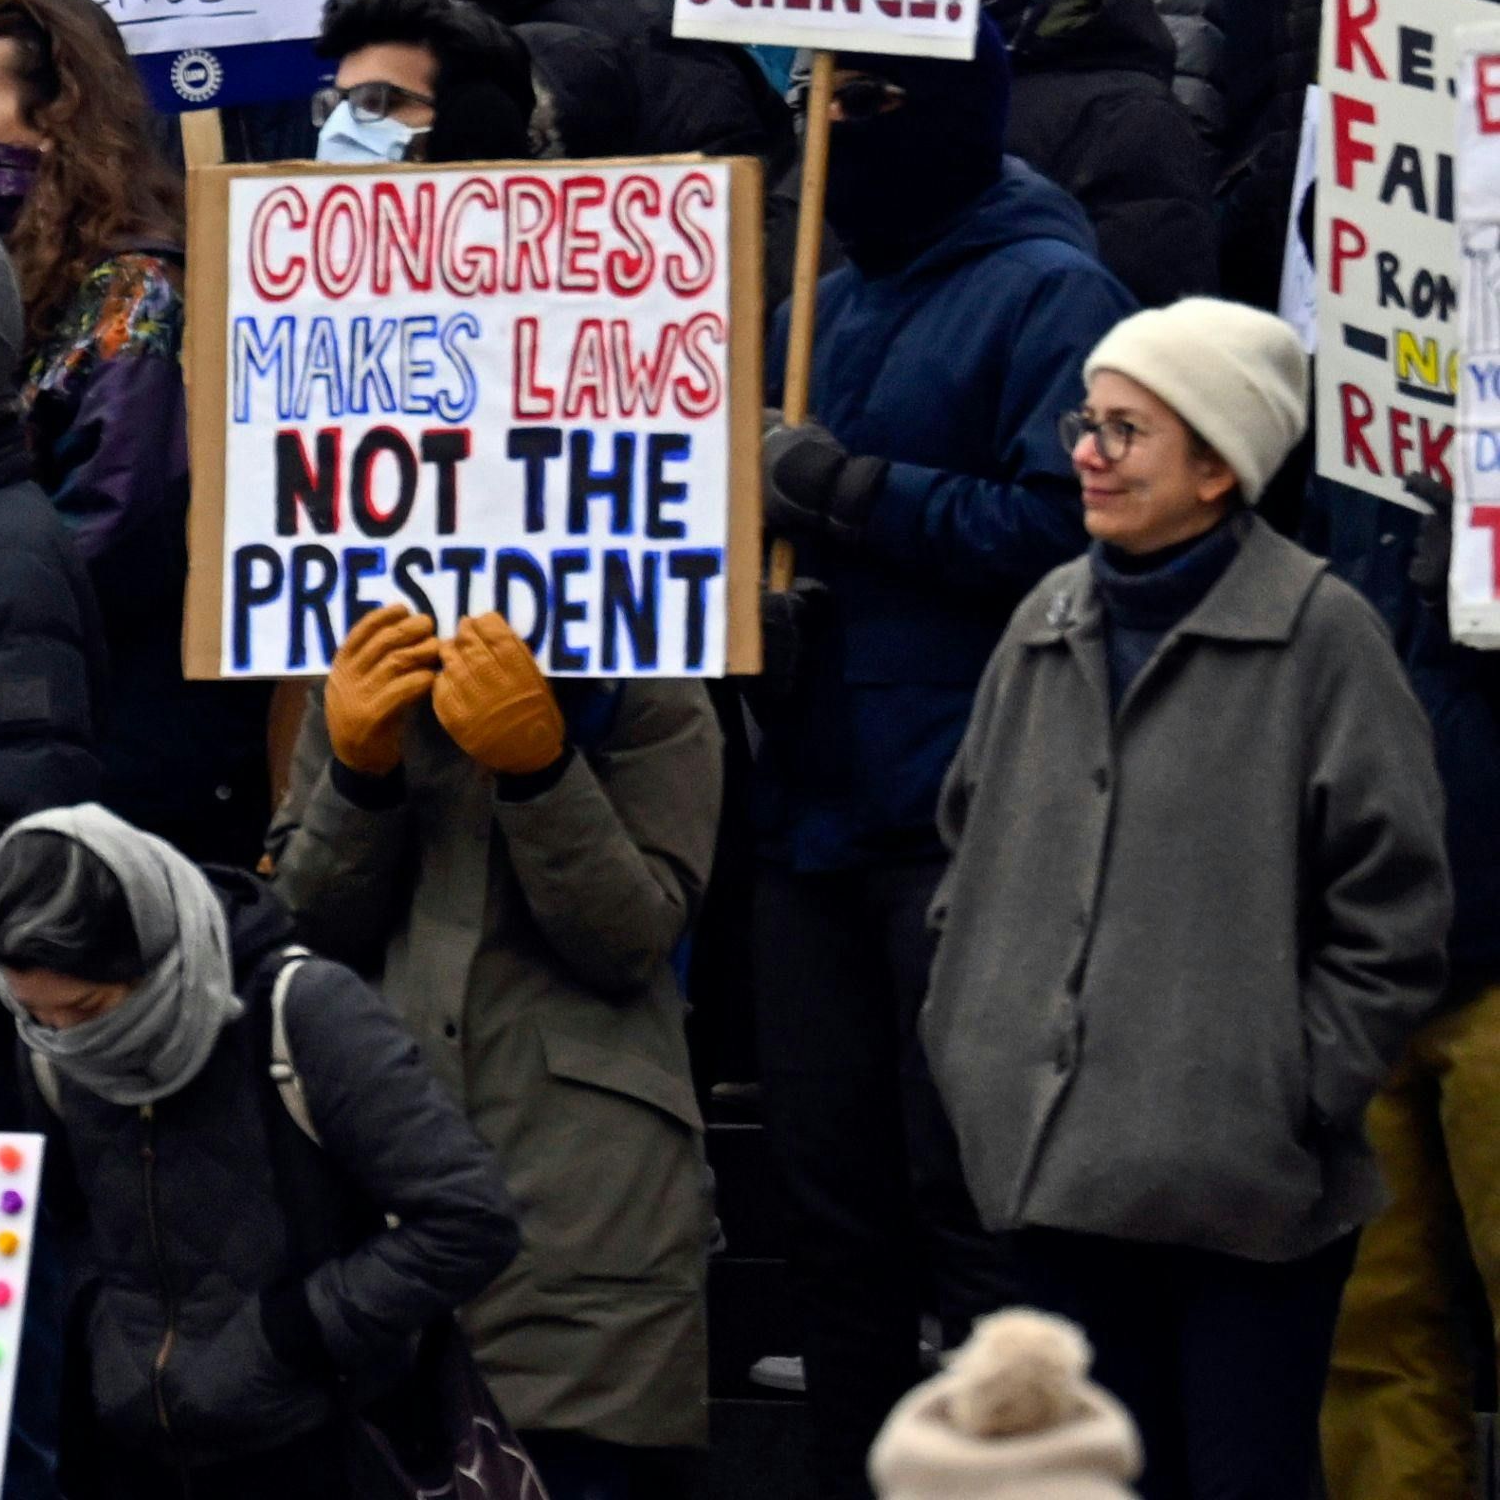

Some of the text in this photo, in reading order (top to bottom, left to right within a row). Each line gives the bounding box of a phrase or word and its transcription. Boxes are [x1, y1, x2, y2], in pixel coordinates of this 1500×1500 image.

[250, 172, 715, 301] CONGRESS
[233, 311, 726, 423] MAKES LAWS
[275, 426, 691, 539] NOT THE
[232, 544, 723, 671] PRESIDENT
